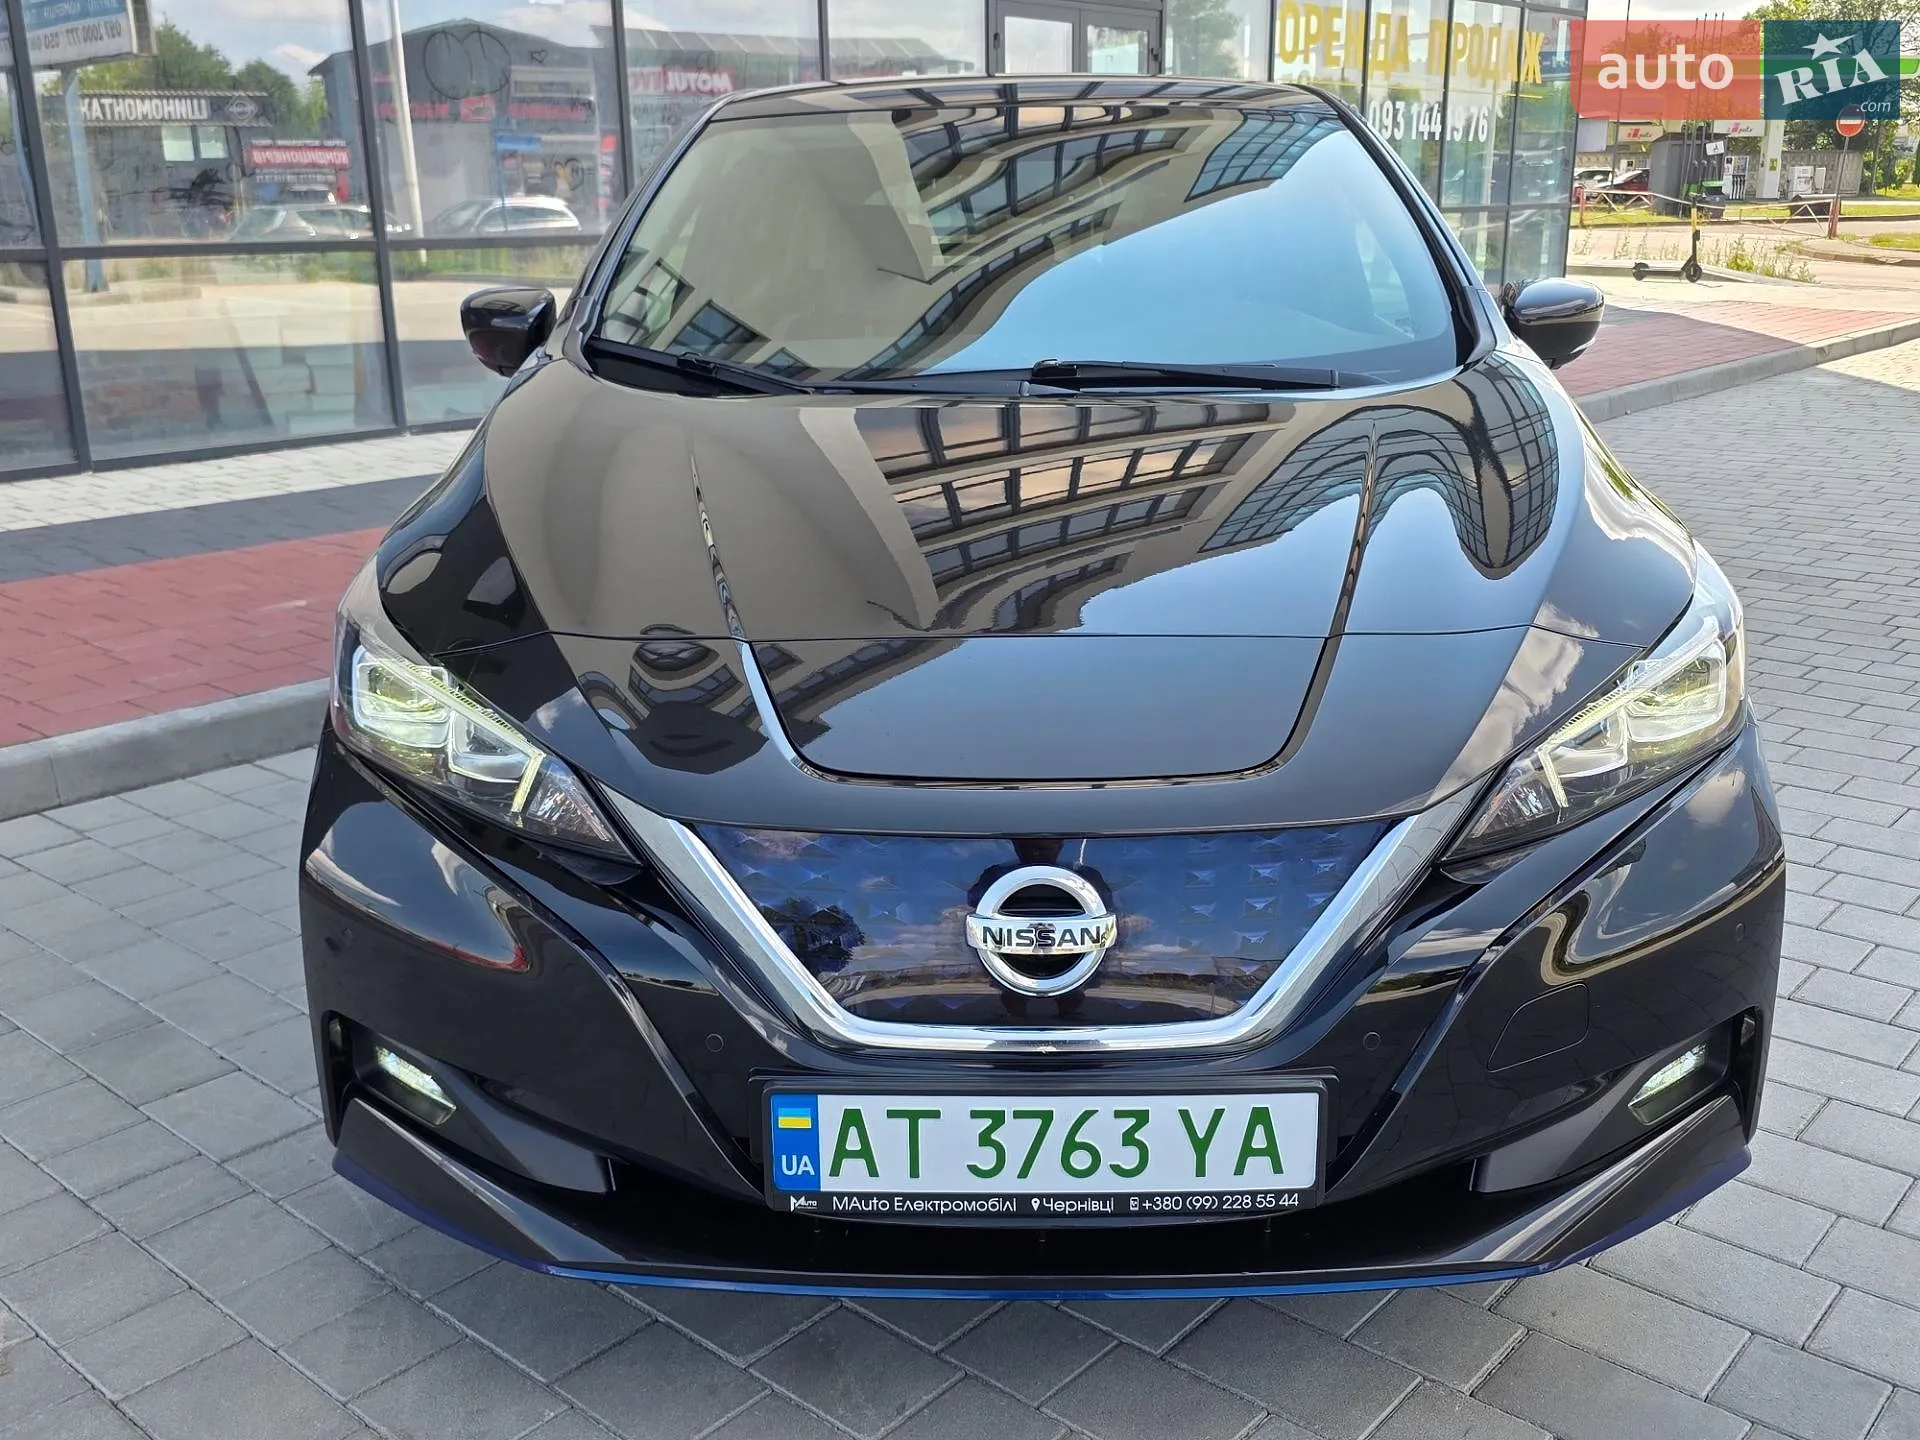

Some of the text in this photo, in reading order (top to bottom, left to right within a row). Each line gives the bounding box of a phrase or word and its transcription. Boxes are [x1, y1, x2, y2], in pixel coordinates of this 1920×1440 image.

[1279, 3, 1545, 84] ОРЕНДА ПРОДАЖ
[1369, 100, 1405, 141] 093
[1411, 102, 1442, 141] 144
[982, 926, 1101, 948] NISSAN
[828, 1106, 1285, 1180] AT 3763 YA
[781, 1155, 815, 1176] UA
[833, 1192, 1299, 1215] MAuto Електромобілі Чернівці +380 (99) 228 55 44
